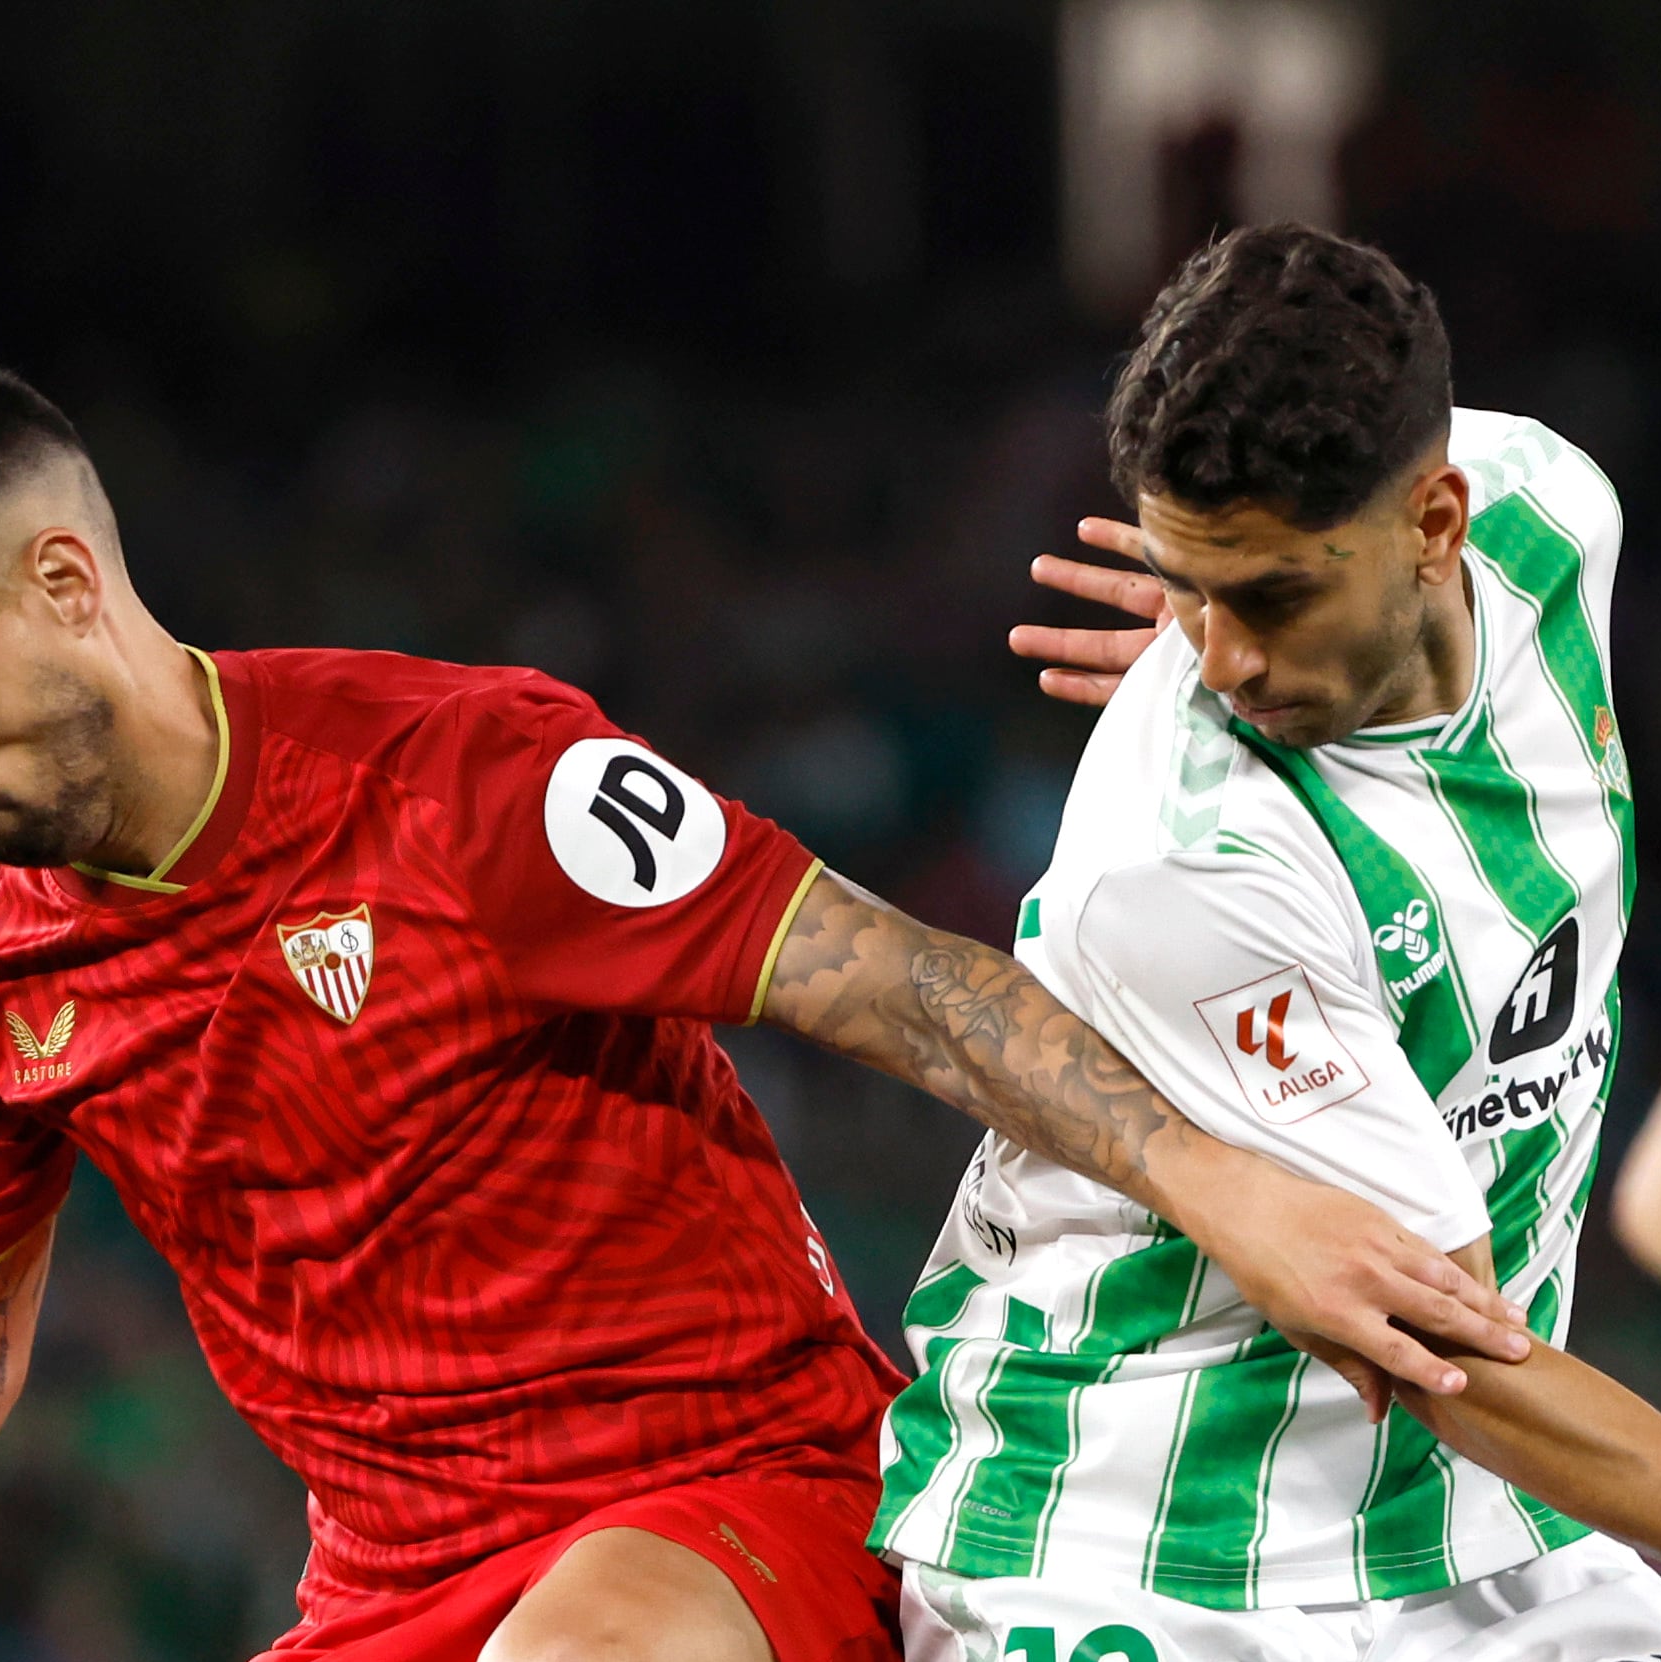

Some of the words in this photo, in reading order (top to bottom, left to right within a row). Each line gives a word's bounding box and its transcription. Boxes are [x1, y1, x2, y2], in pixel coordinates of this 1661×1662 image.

[588, 755, 686, 892] JD
[1389, 951, 1445, 1000] humm
[14, 1061, 73, 1084] CASTORE
[1262, 1060, 1345, 1107] LALIGA
